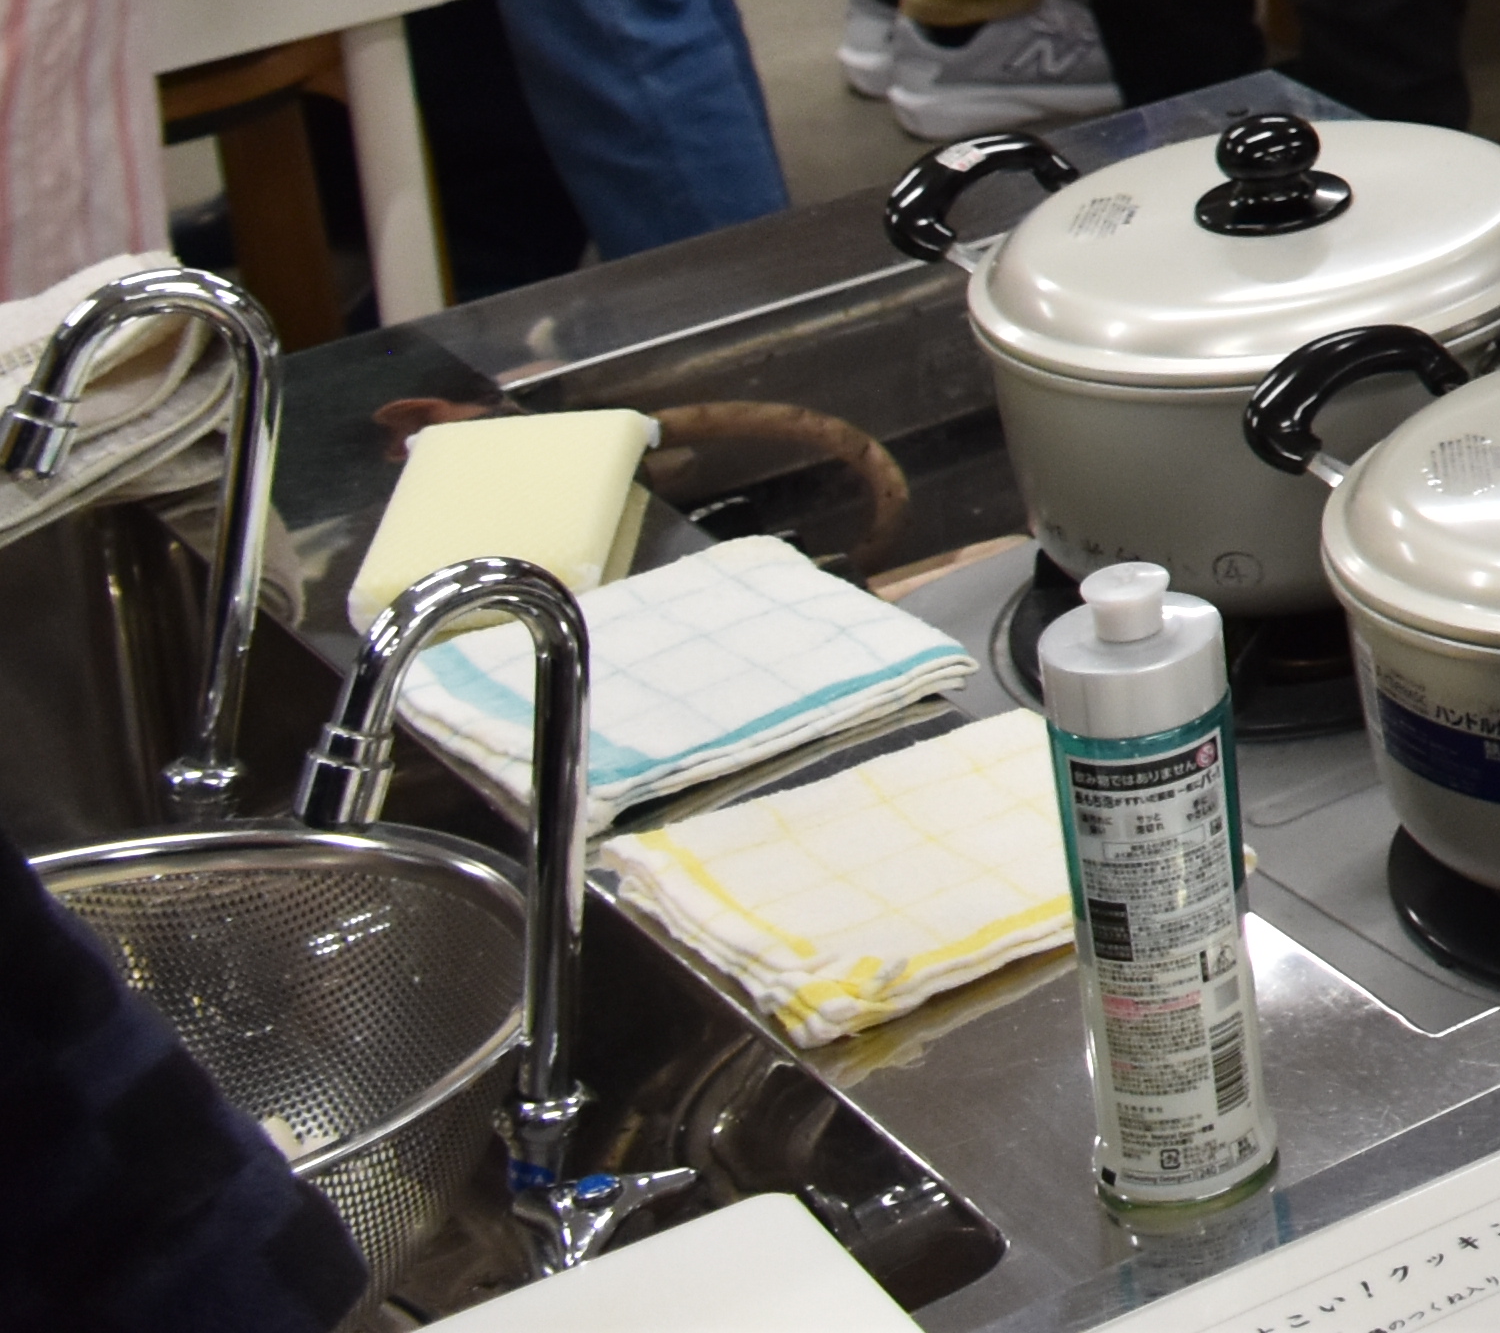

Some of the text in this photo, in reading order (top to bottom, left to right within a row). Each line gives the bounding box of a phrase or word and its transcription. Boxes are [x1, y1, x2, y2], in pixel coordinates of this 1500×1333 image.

[1074, 761, 1197, 787] 飲み物ではありません
